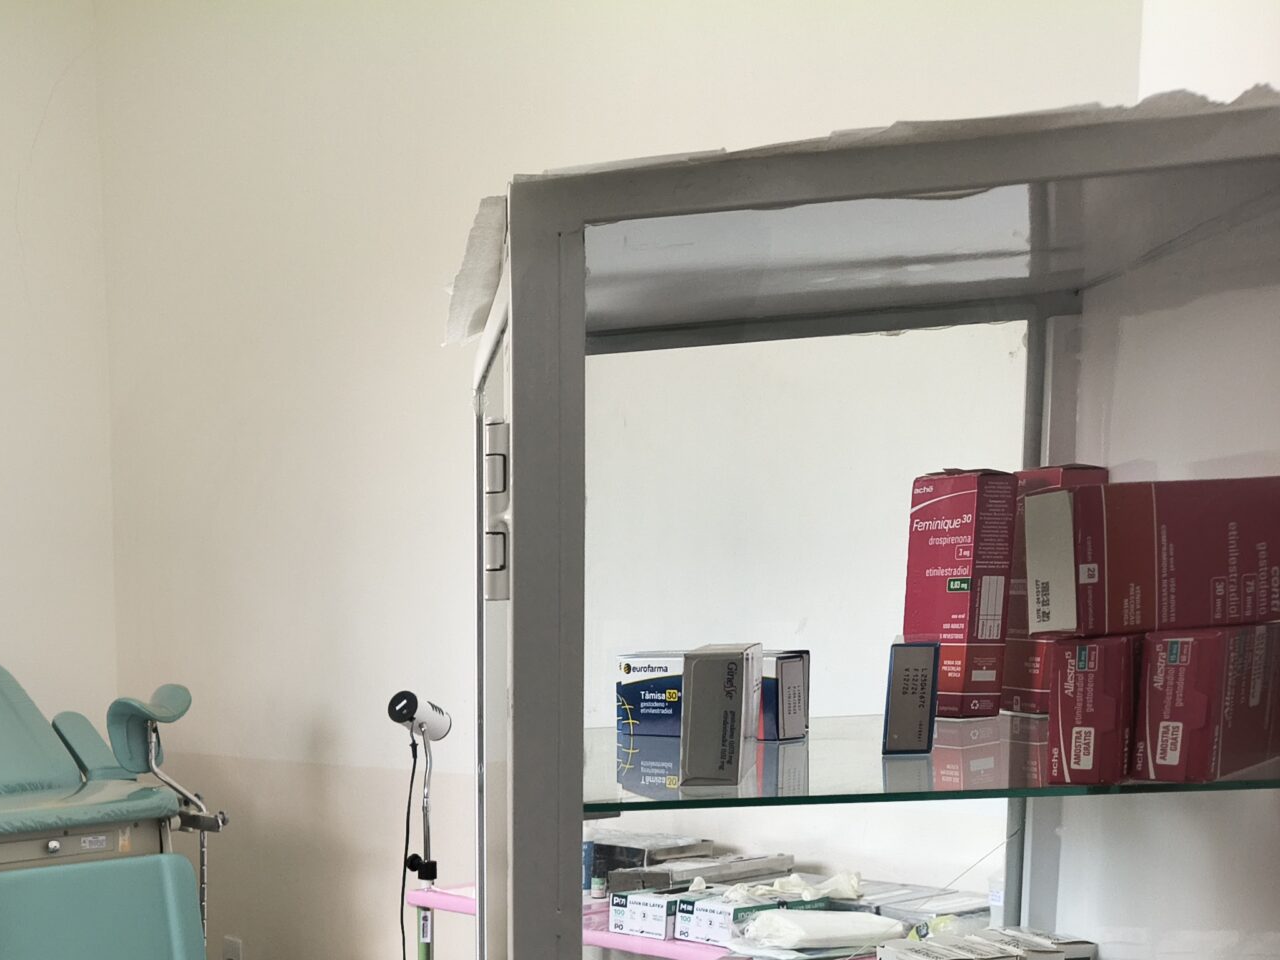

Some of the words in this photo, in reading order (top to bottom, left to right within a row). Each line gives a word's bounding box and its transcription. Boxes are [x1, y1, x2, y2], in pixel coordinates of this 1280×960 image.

[928, 535, 971, 546] drospirenona
[926, 565, 969, 576] etinilestradiol
[632, 664, 668, 673] eurofarma
[640, 691, 665, 700] Tâmisa
[667, 691, 677, 700] 30
[1083, 730, 1092, 756] GRÁTIS
[1159, 724, 1170, 760] AMOSTRA
[1073, 730, 1082, 766] AMOSTRA
